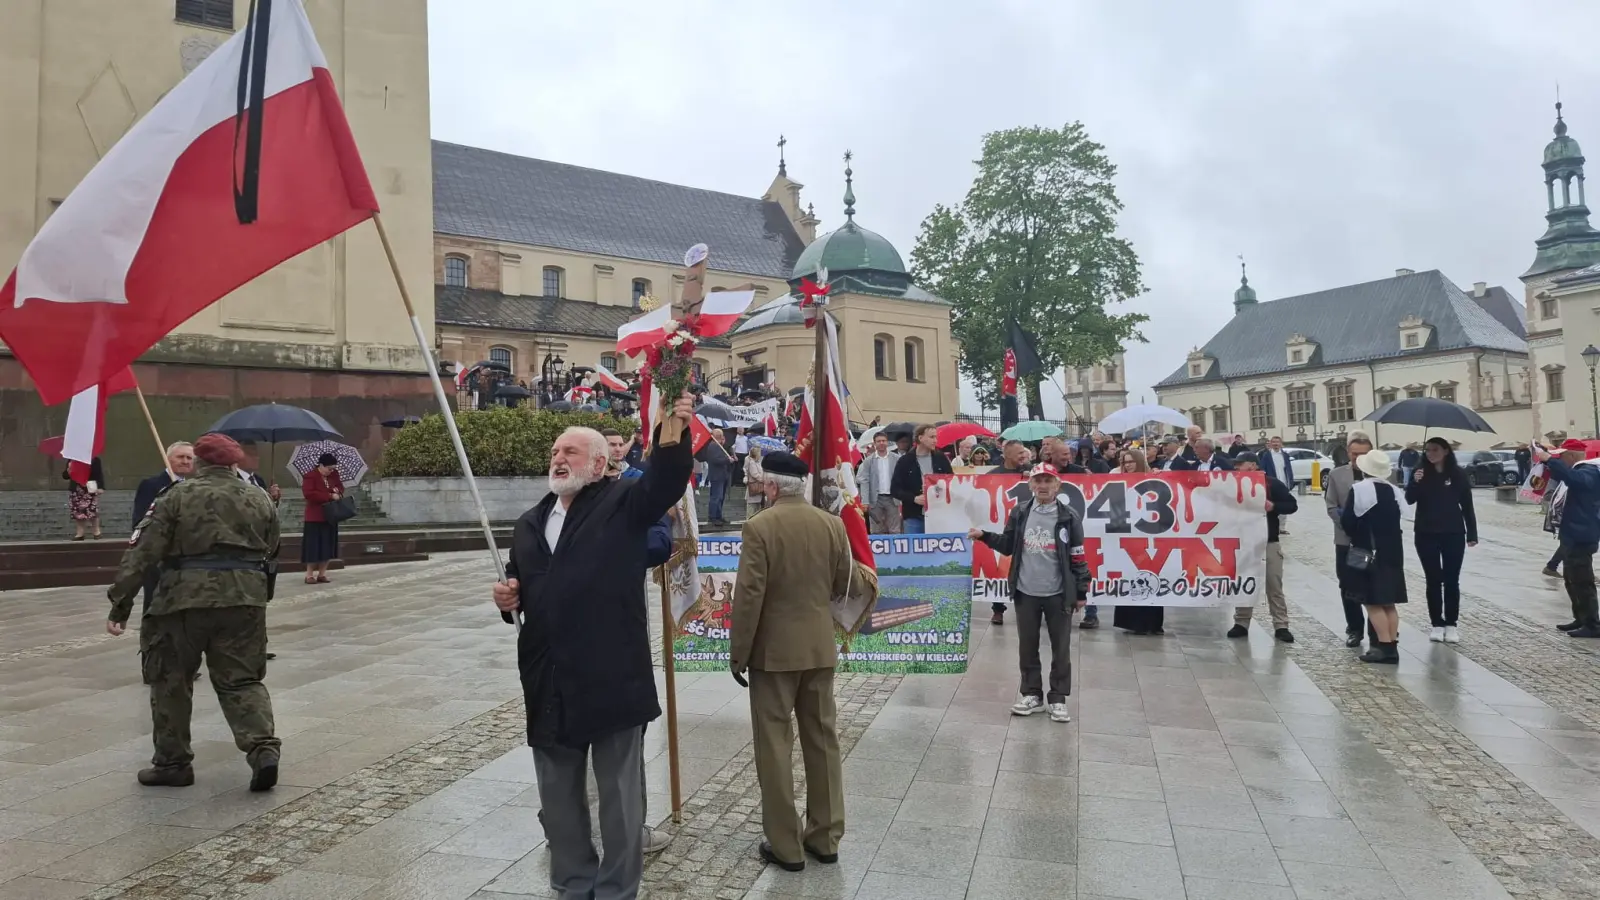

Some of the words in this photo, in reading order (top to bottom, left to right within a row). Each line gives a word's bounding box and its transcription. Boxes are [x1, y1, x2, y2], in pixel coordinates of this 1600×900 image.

[869, 540, 889, 553] CI
[895, 539, 908, 553] 11
[914, 538, 965, 552] LIPCA
[972, 521, 1241, 590] ŁYŃ
[684, 620, 705, 636] ŚĆ
[707, 627, 730, 639] ICH
[886, 629, 938, 644] WOŁYŃ
[673, 652, 715, 660] OŁECZNY
[847, 651, 913, 661] WOŁYŃSKIEGO
[916, 653, 925, 661] W
